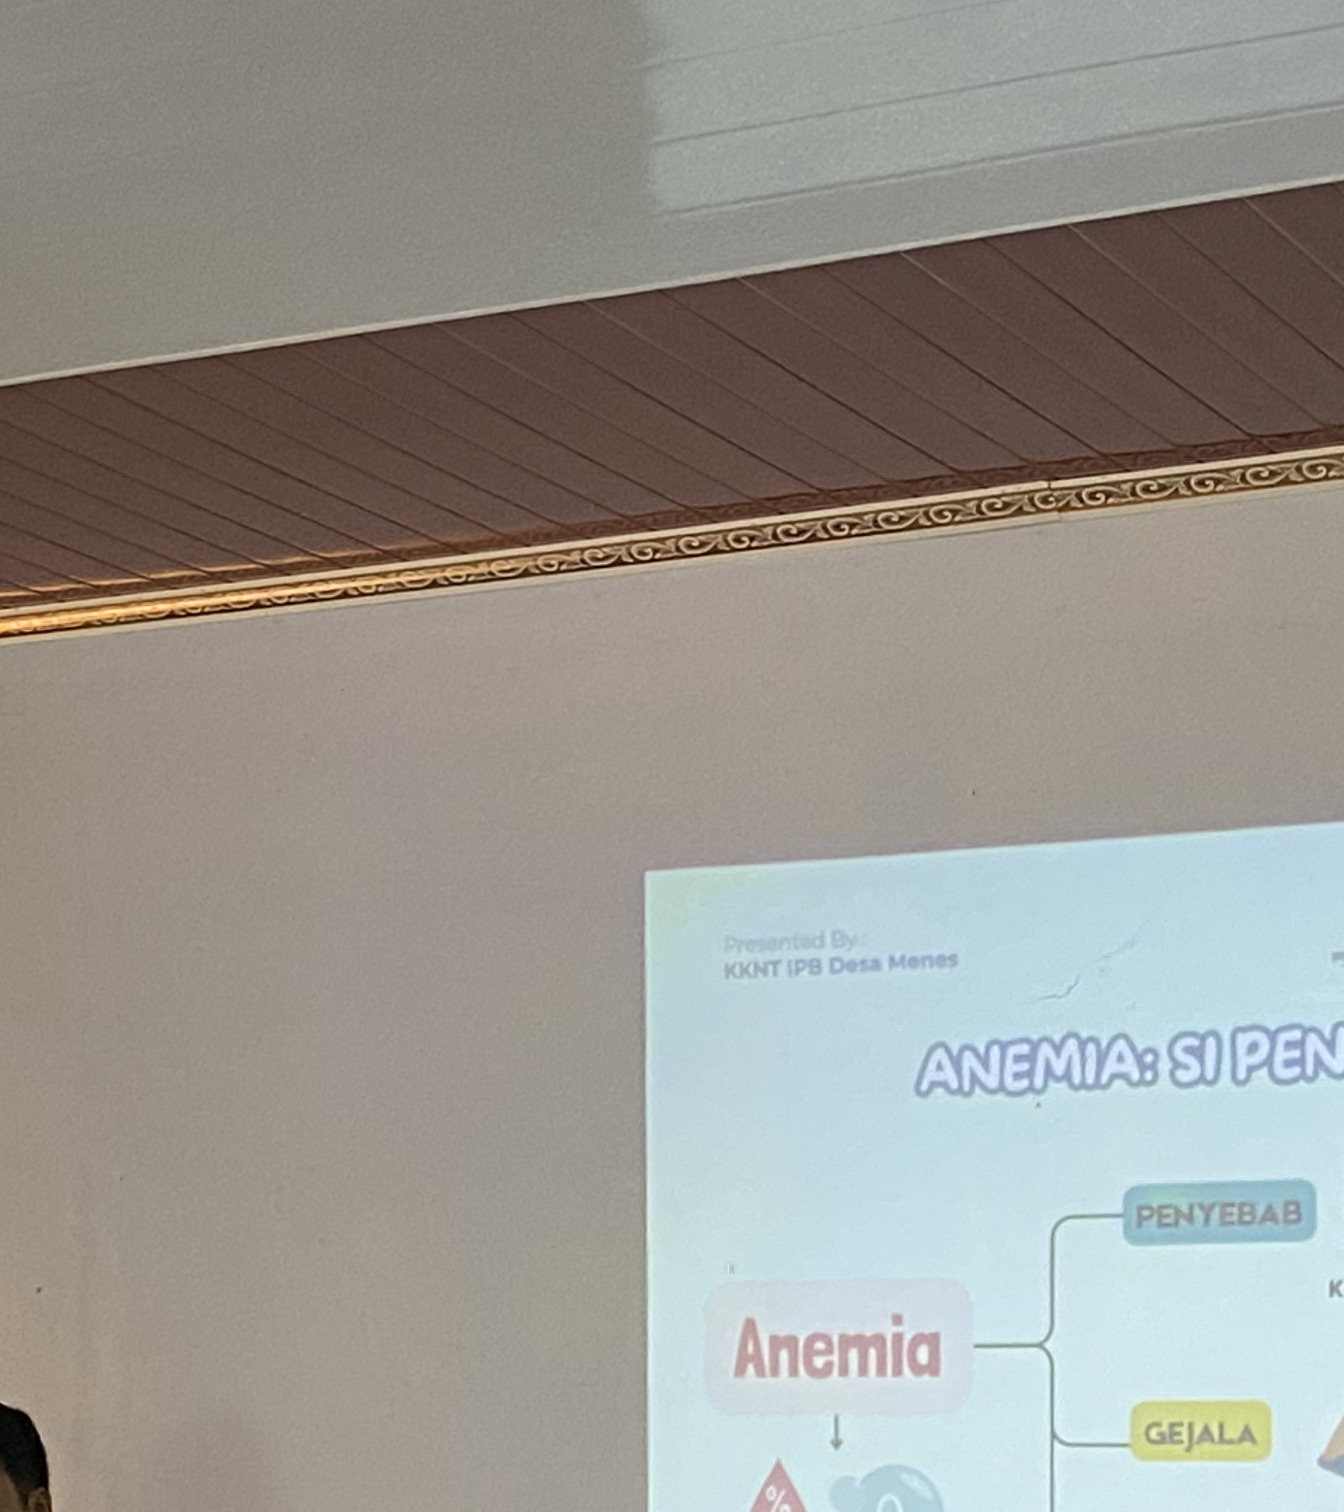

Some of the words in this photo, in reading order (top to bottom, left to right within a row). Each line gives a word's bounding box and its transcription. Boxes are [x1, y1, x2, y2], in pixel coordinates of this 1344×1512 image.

[724, 931, 825, 953] Presented
[724, 960, 781, 980] KKNT
[787, 957, 822, 978] IPB
[829, 956, 882, 975] Desa
[888, 953, 959, 972] Menes
[915, 1031, 1158, 1098] ANEMIA:
[1167, 1030, 1222, 1089] SI
[1135, 1198, 1303, 1229] PENYEBAB
[734, 1313, 942, 1379] Anemia
[1144, 1421, 1258, 1452] GEJALA
